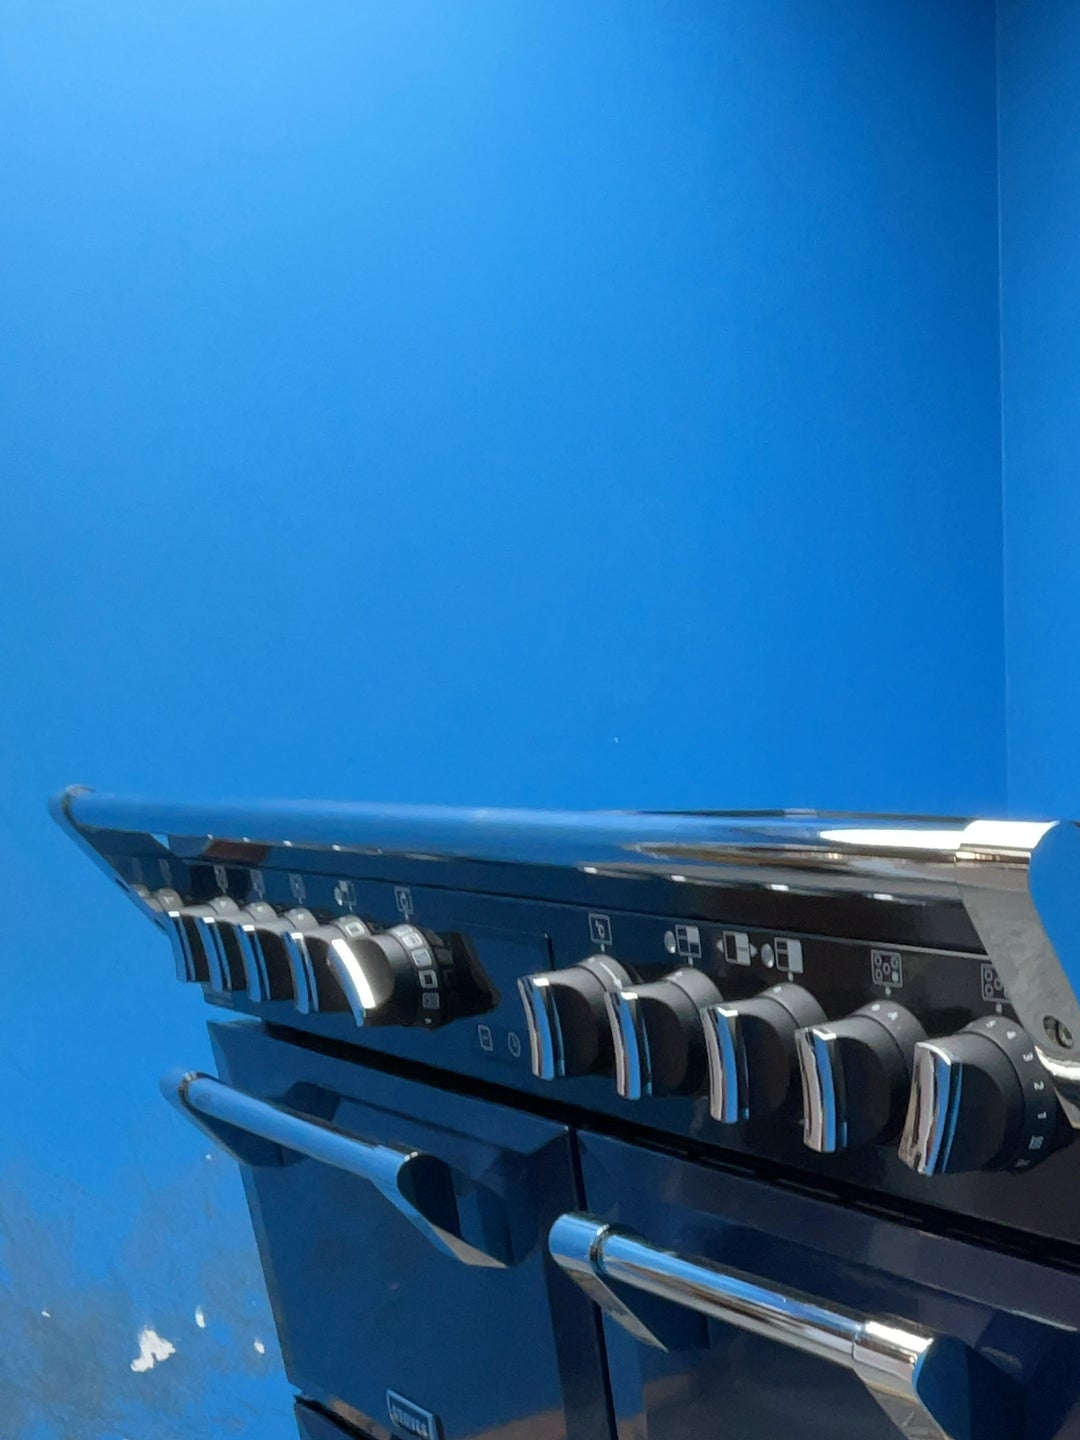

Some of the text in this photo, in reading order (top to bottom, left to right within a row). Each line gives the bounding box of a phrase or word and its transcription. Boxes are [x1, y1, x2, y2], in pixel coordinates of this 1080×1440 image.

[1006, 1030, 1017, 1040] 4
[1022, 1051, 1034, 1062] 3
[1033, 1080, 1045, 1090] 2
[1037, 1111, 1048, 1120] 1
